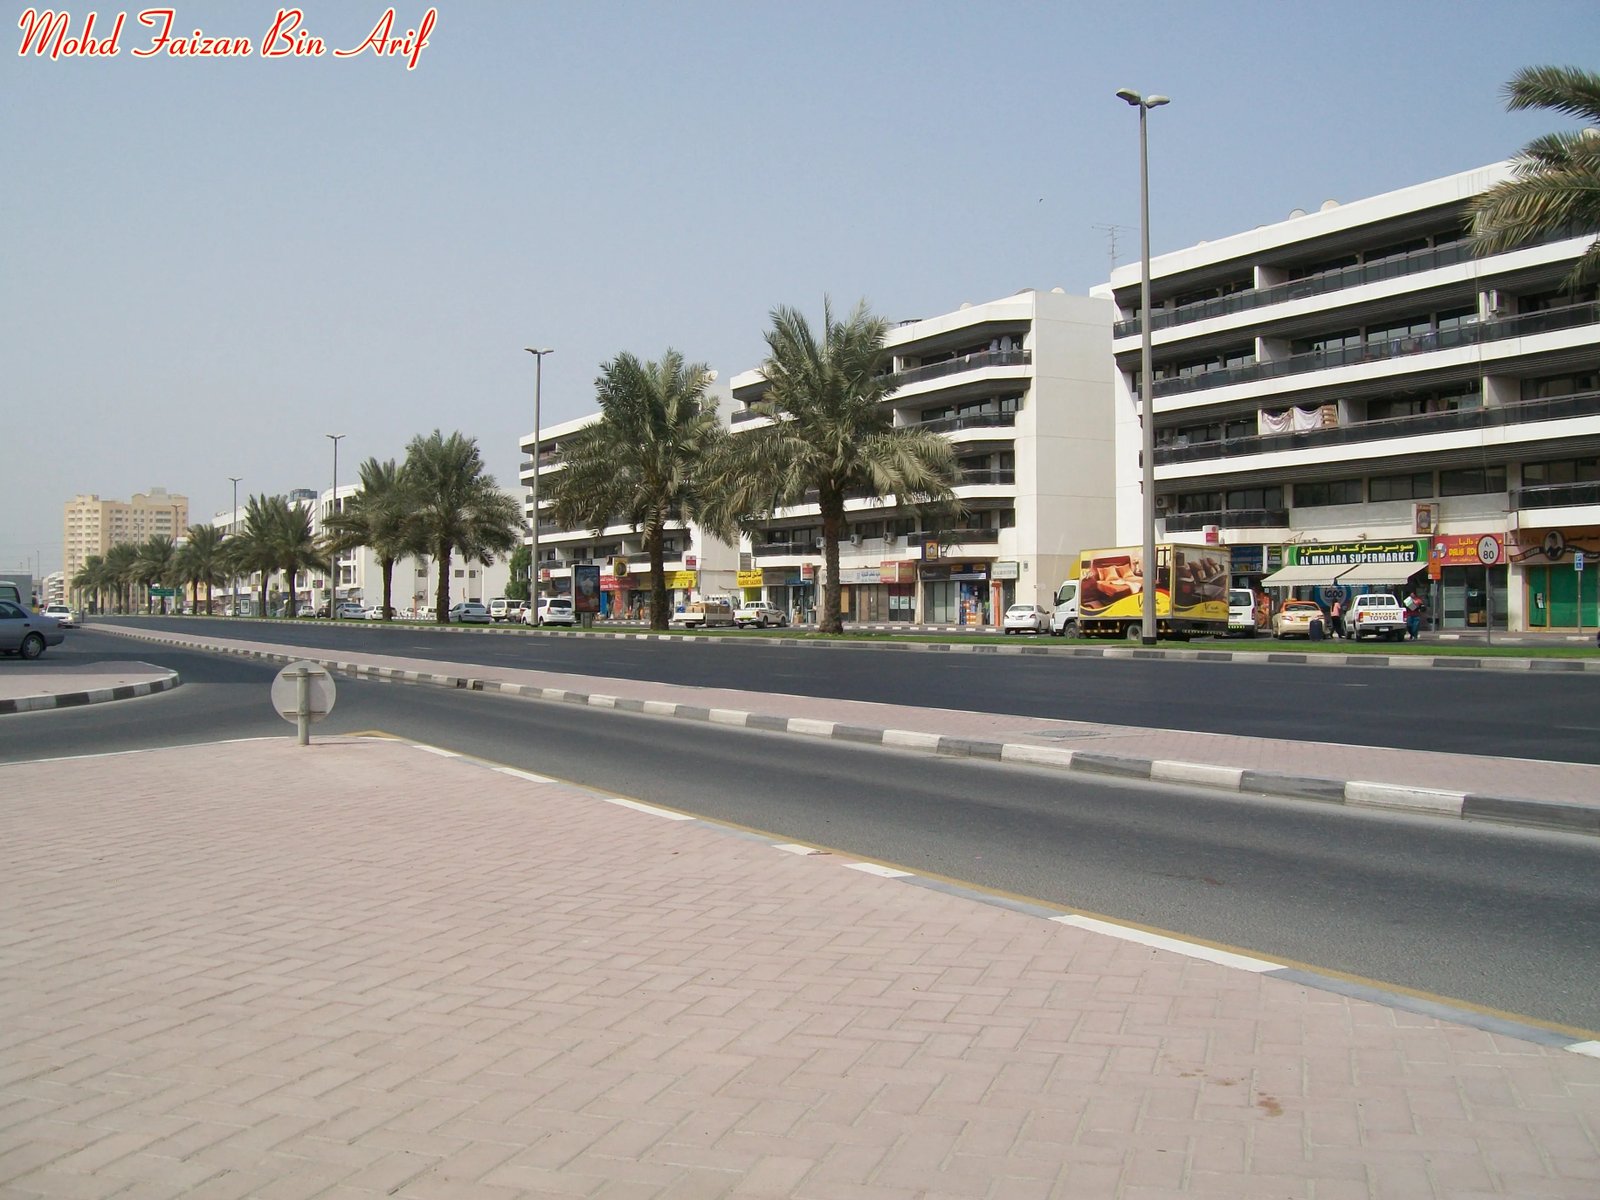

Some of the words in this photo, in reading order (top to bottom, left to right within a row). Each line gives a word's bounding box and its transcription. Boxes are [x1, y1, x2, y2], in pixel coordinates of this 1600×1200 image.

[1300, 556, 1309, 565] AL
[1312, 554, 1347, 564] MANARA
[1349, 551, 1415, 563] SUPERMARKET
[1483, 550, 1494, 560] 80
